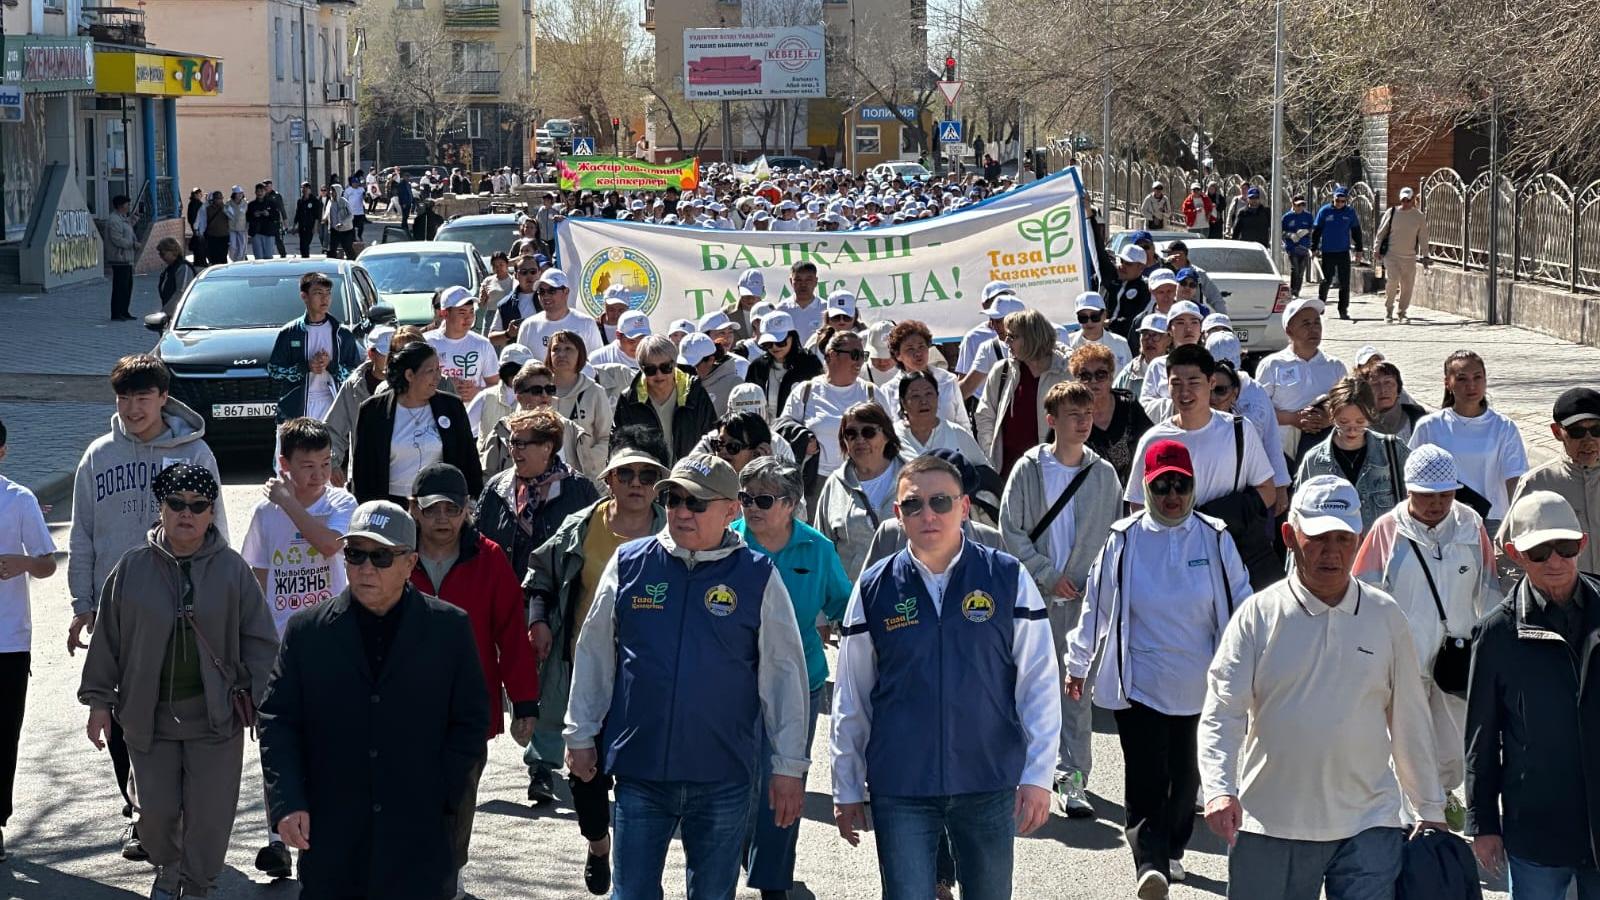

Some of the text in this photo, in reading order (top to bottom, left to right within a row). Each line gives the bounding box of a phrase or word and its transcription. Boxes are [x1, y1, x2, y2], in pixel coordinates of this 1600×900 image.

[862, 108, 915, 119] ПОЛИИЯ
[697, 235, 912, 271] БАЛҚАШ
[987, 250, 1043, 267] Таза
[224, 404, 278, 416] 867 BN 09
[96, 461, 162, 503] BORNQA
[140, 499, 161, 513] 165
